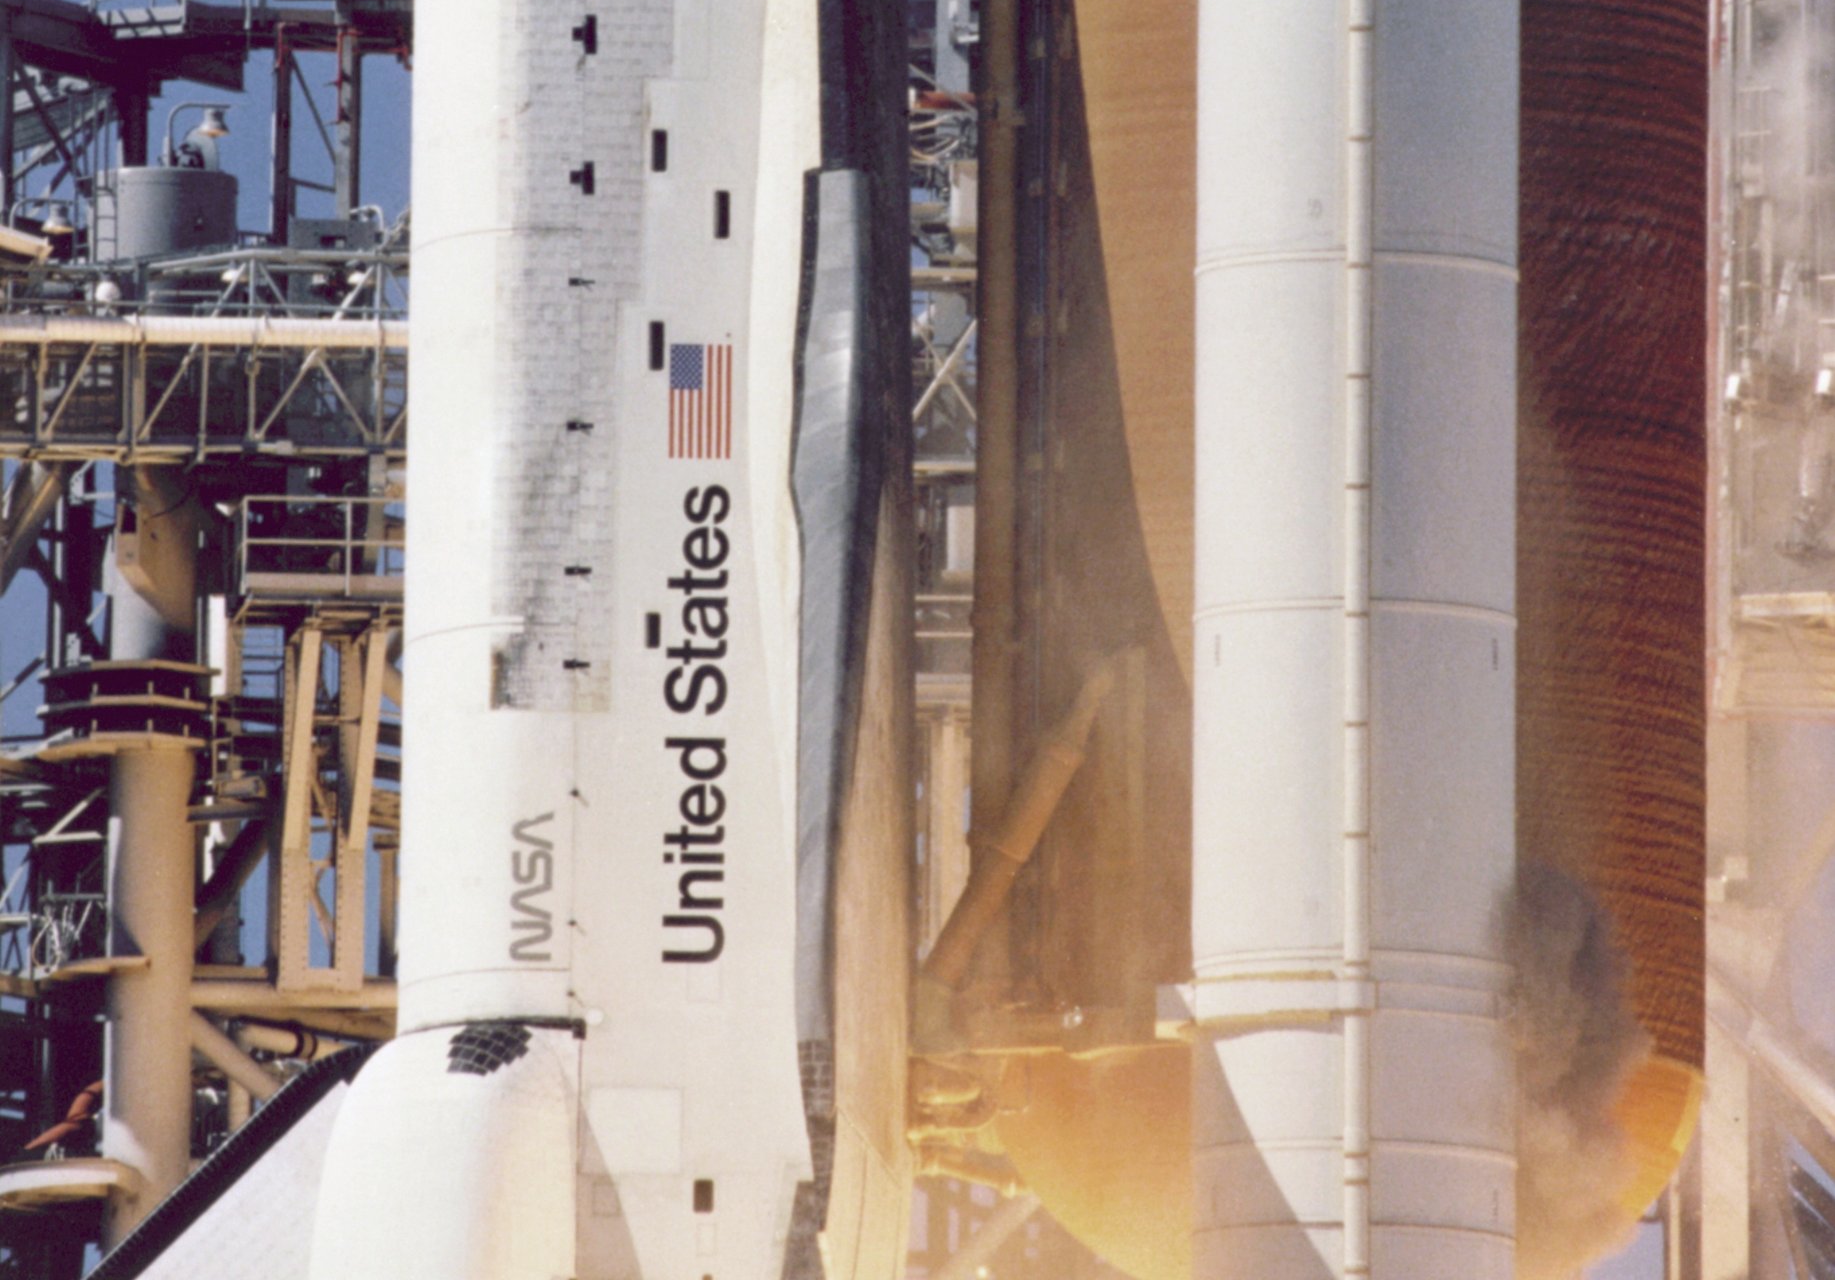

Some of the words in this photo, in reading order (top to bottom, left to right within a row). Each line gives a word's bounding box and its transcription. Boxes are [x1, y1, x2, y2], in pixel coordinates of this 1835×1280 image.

[663, 484, 731, 716] States
[510, 811, 555, 963] NASA
[661, 737, 727, 963] United
